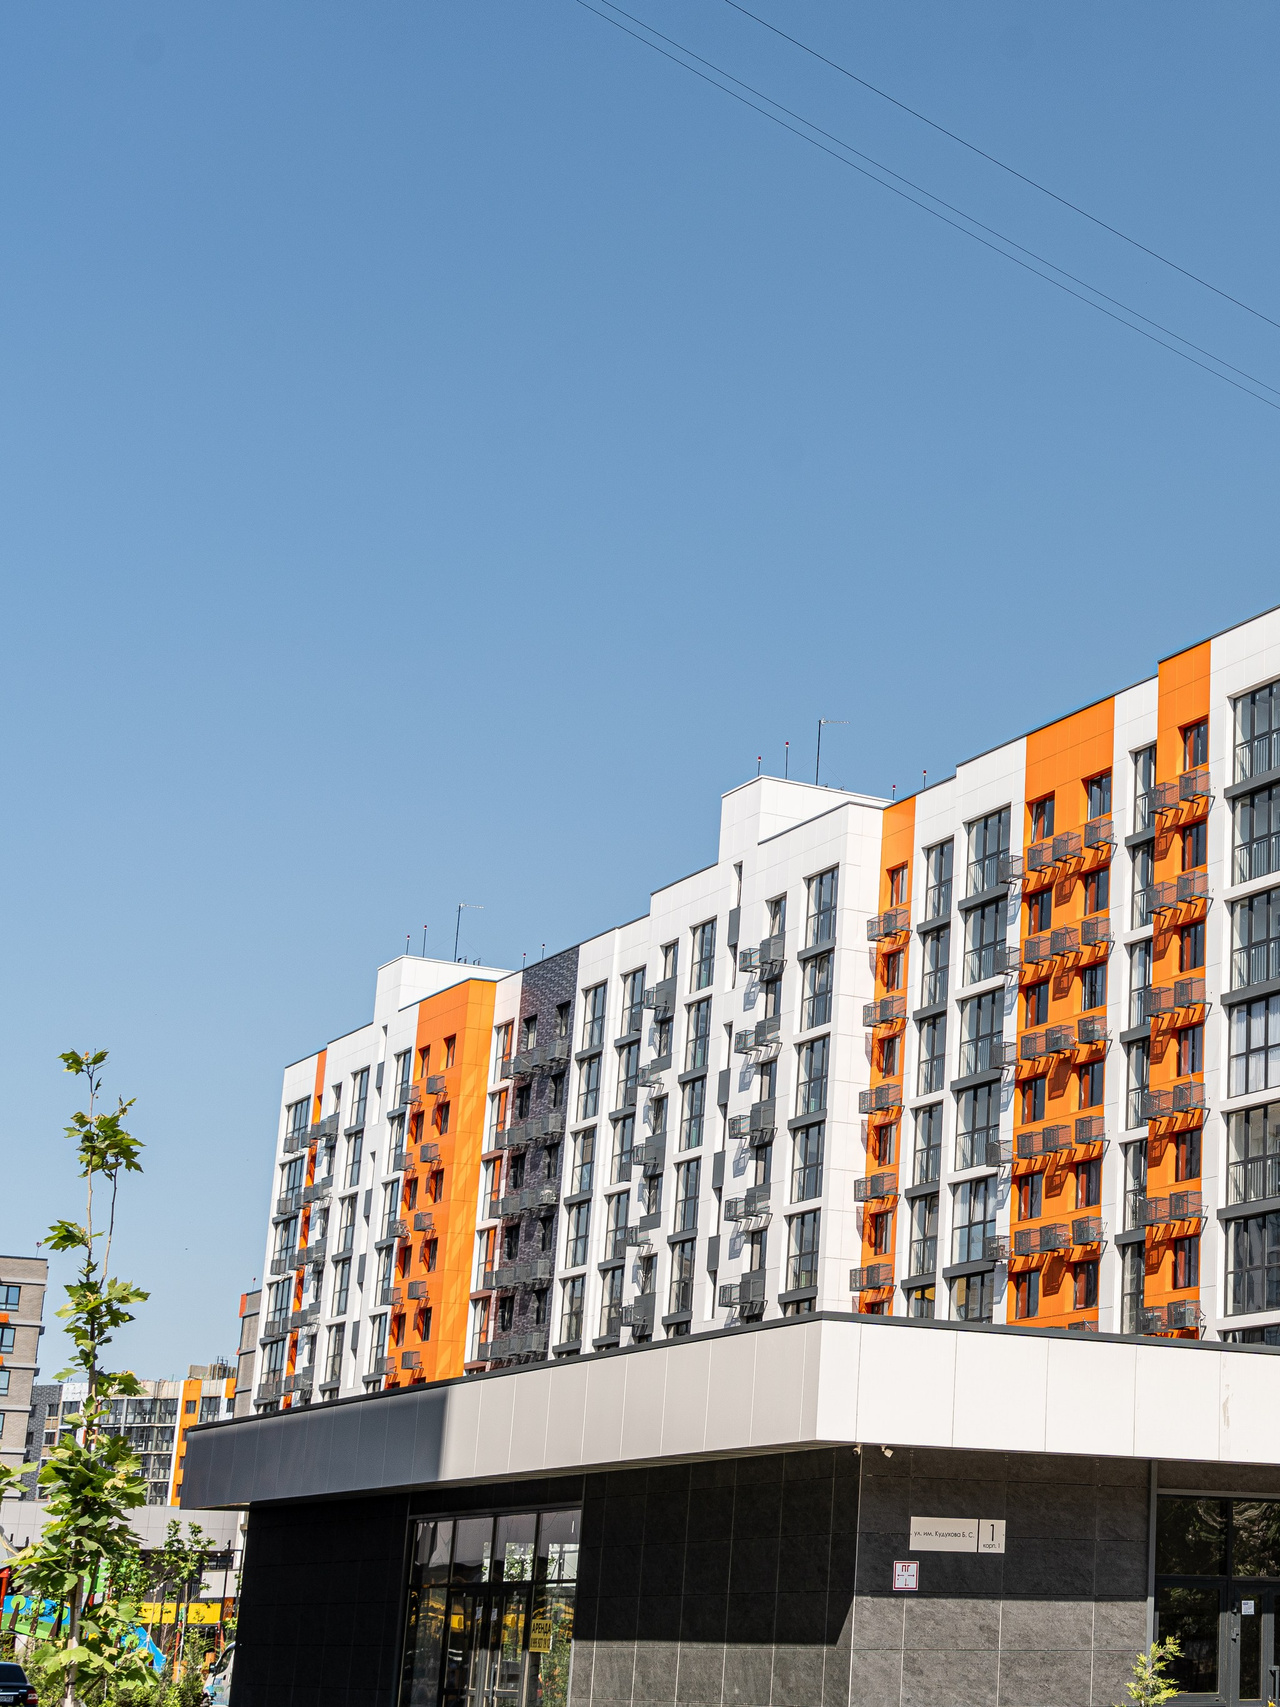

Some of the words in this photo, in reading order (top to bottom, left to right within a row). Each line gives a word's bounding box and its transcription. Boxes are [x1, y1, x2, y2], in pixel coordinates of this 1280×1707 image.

[990, 1524, 995, 1542] 1
[901, 1564, 911, 1573] ПГ
[532, 1622, 551, 1637] АРЕНДА
